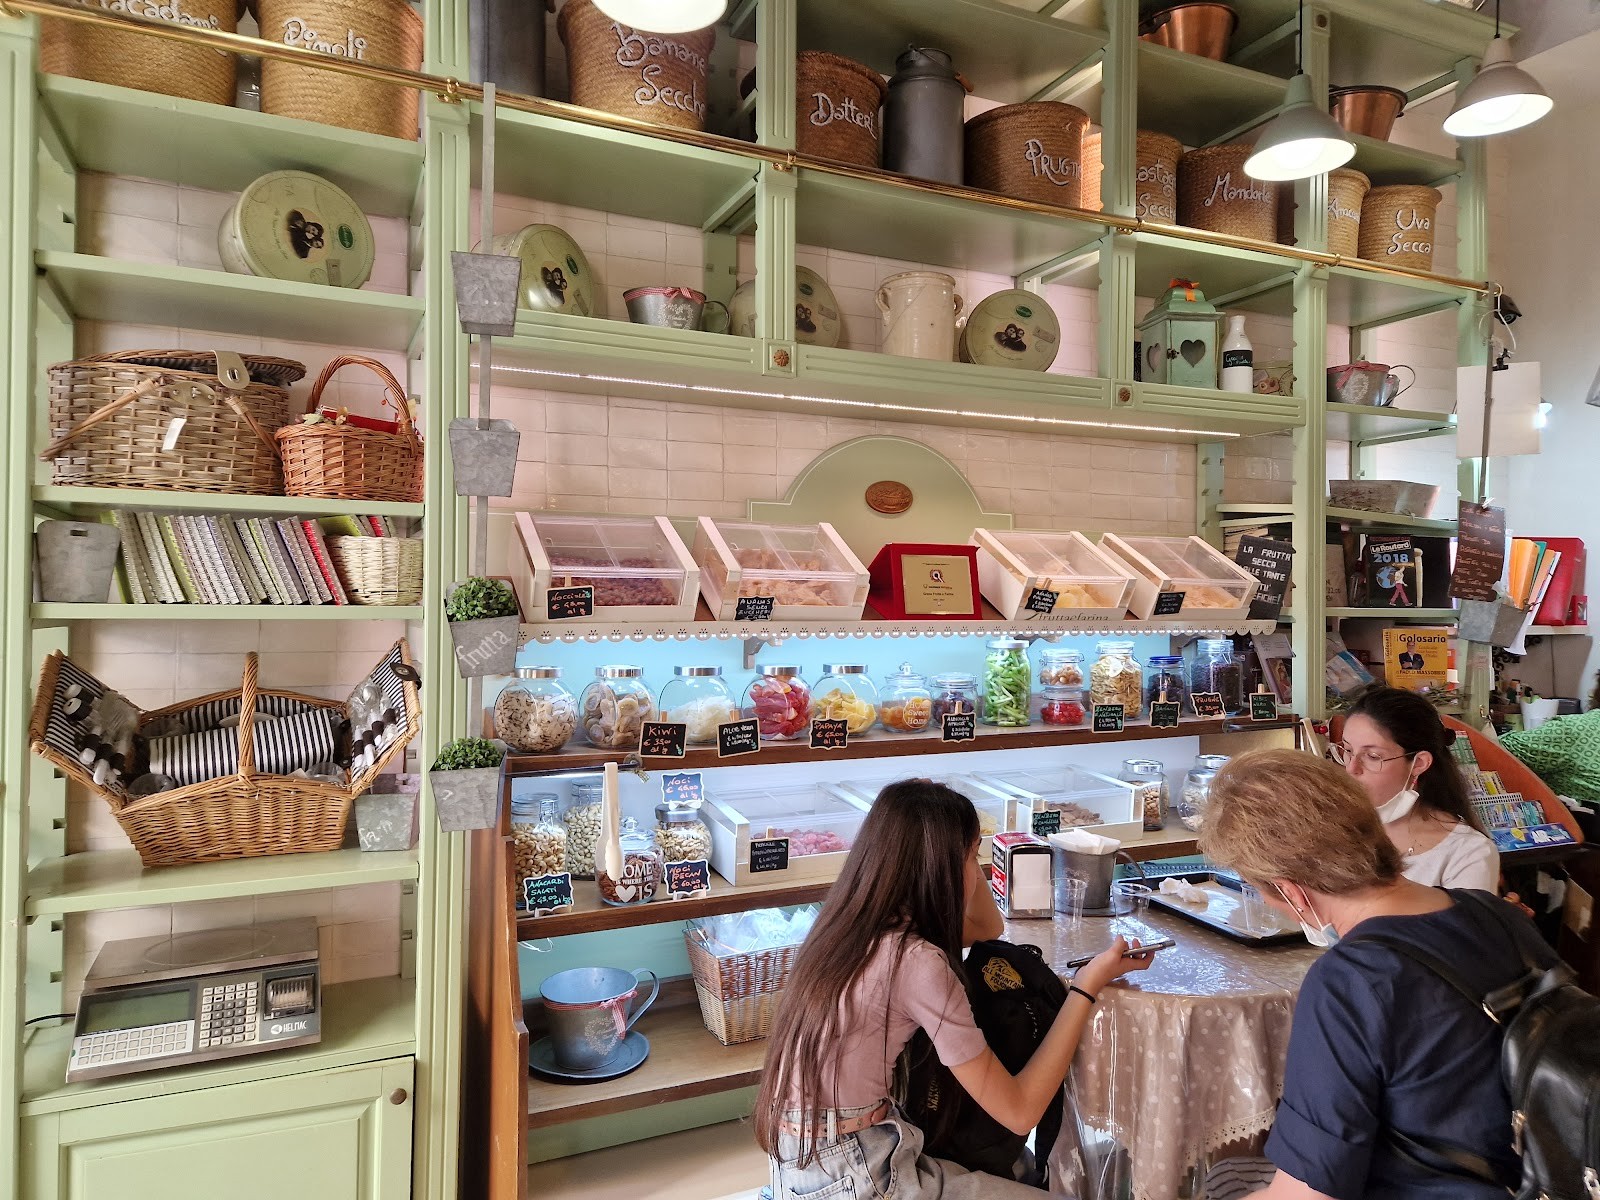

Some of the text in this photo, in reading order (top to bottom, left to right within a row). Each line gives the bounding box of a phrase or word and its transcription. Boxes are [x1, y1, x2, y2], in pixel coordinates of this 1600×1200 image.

[1396, 208, 1430, 231] Uva
[1387, 232, 1431, 255] Secca
[1380, 542, 1409, 552] Routard
[1243, 545, 1291, 562] LA FRUTTA
[1373, 553, 1408, 563] 2018
[1252, 557, 1277, 569] SECCA
[1240, 565, 1286, 581] ALLE TANTE
[1399, 633, 1446, 643] Golosario
[455, 630, 512, 669] frutta
[648, 725, 677, 736] Kiwi
[723, 726, 740, 735] ALOE
[814, 721, 842, 731] PAPAYA
[621, 861, 653, 878] OME
[671, 869, 702, 882] PECAN
[671, 881, 679, 889] €
[637, 882, 653, 901] IS
[529, 897, 536, 905] €
[283, 1020, 307, 1033] HELMAC
